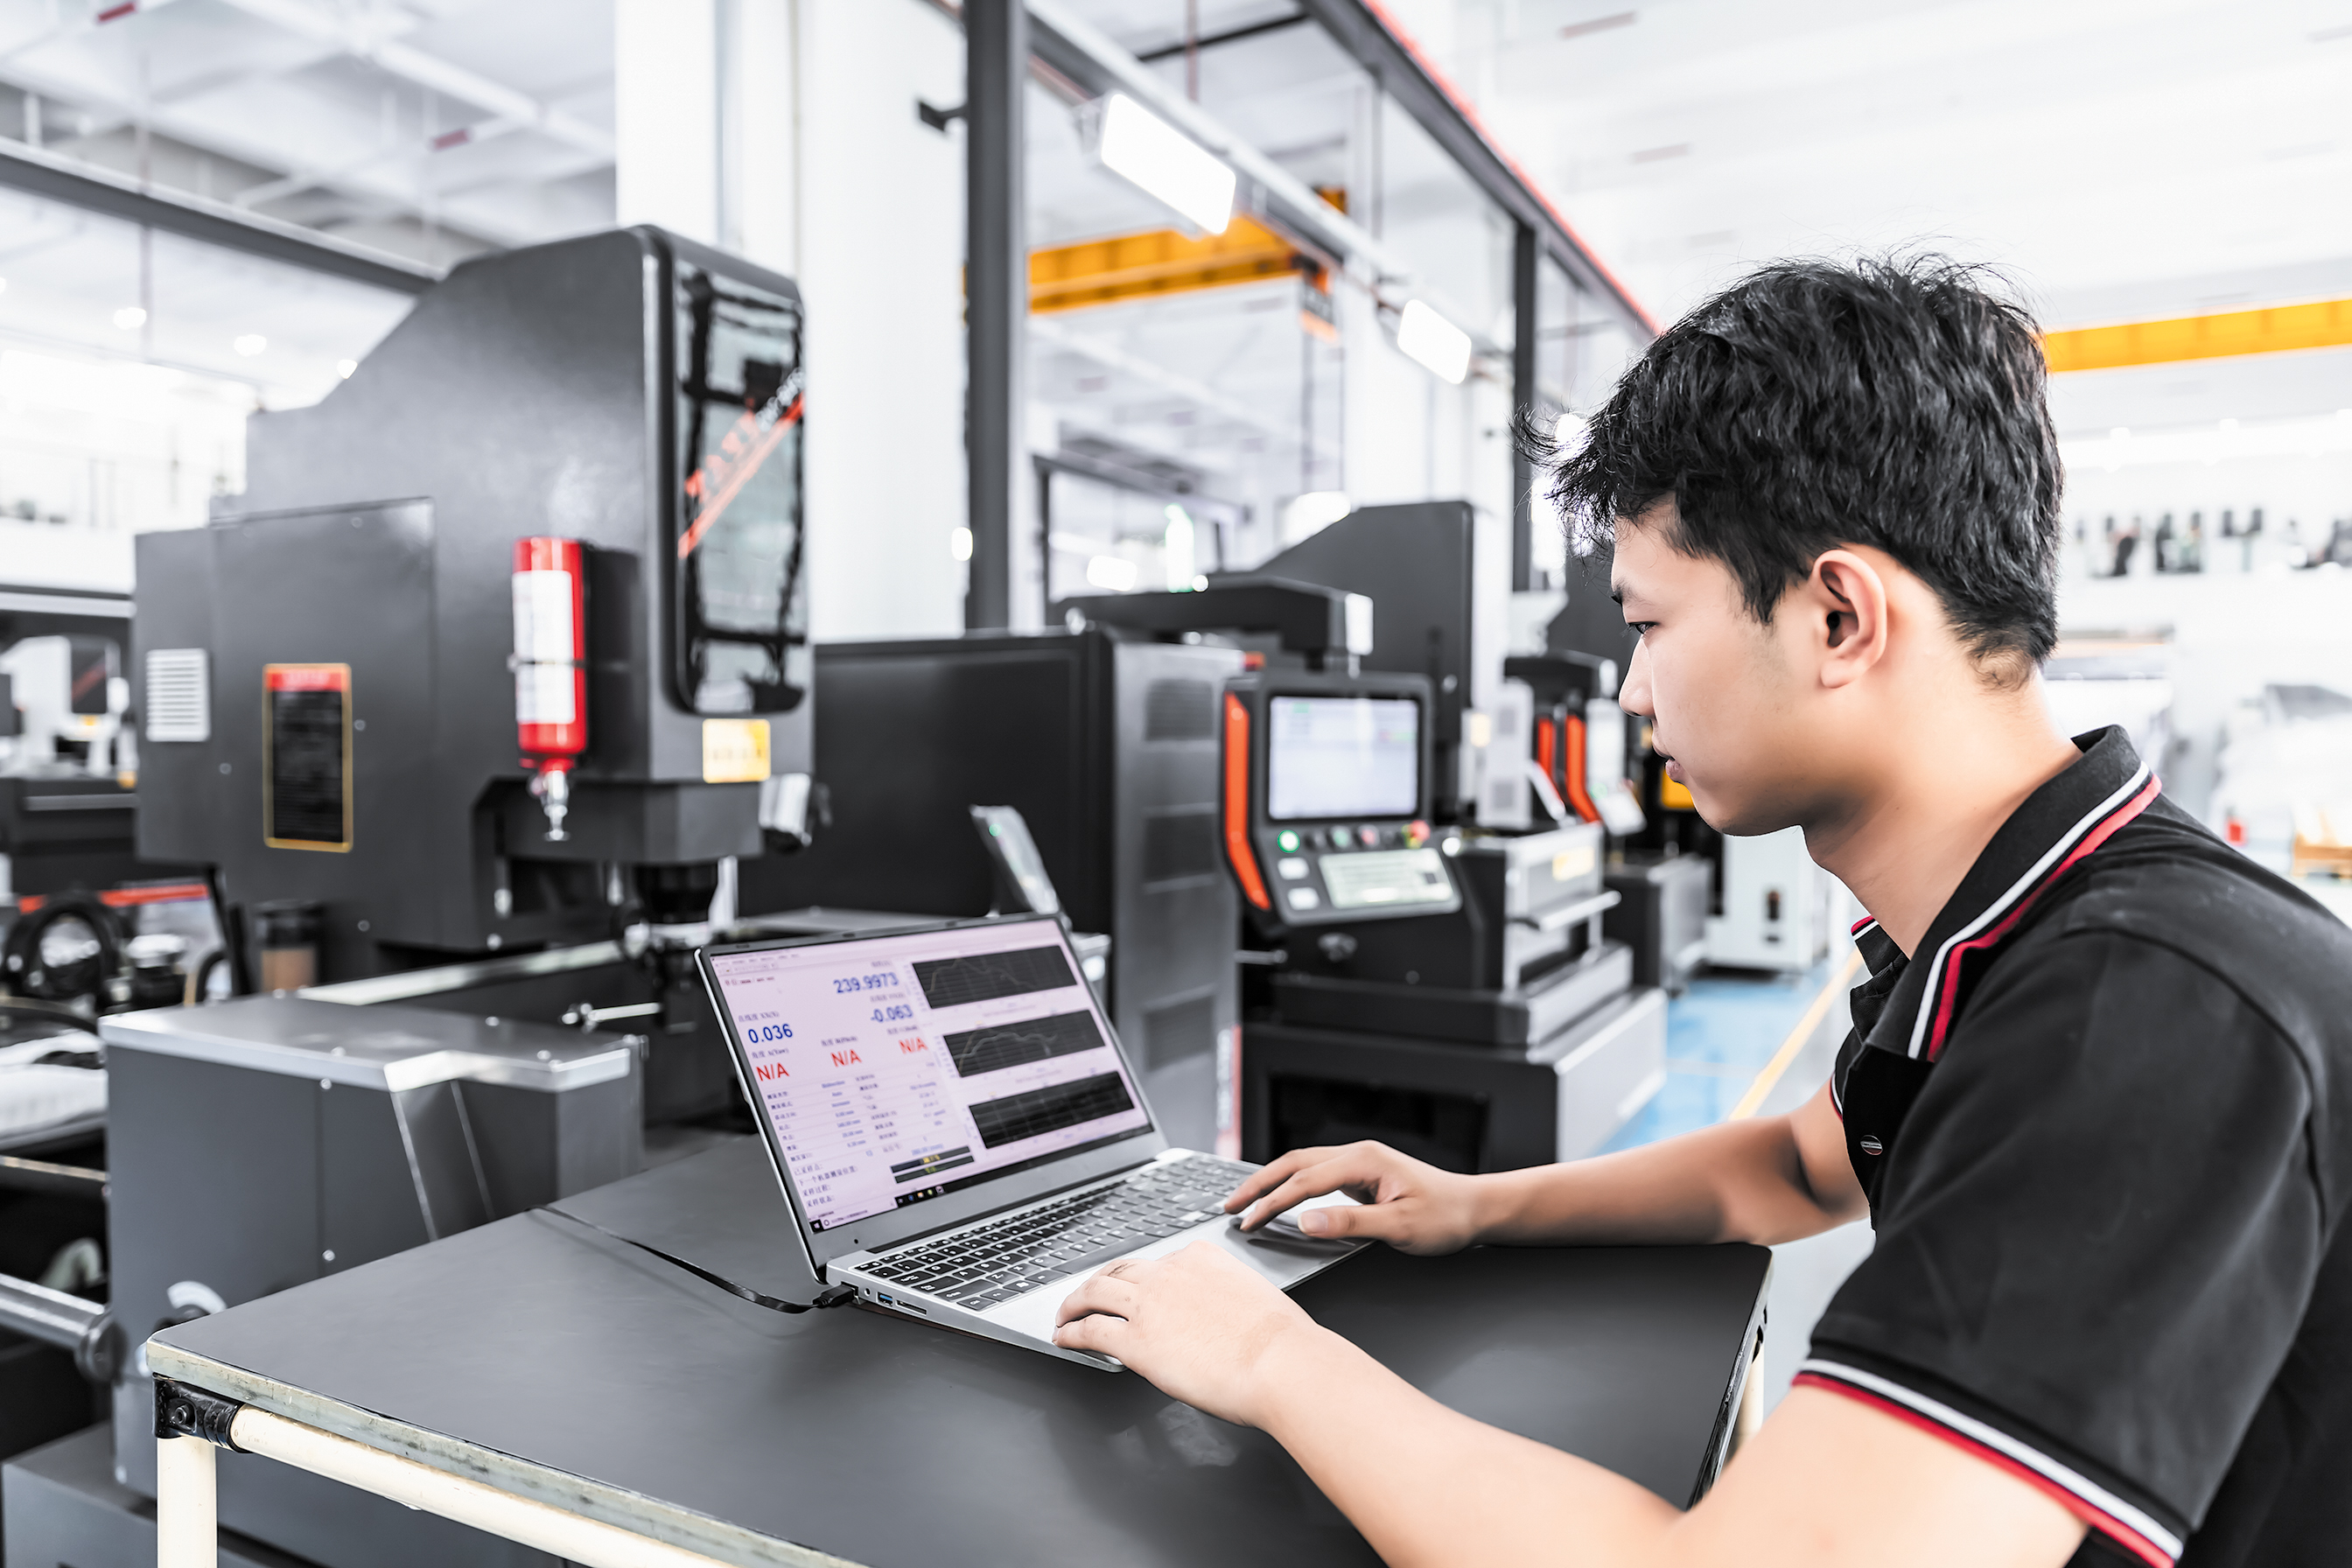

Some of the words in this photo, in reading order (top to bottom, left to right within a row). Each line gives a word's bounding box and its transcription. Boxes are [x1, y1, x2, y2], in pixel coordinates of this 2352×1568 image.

[833, 971, 900, 994] 239.9973
[870, 1004, 914, 1023] -0.063
[747, 1023, 794, 1044] 0.036
[898, 1036, 928, 1055] N/A
[830, 1048, 863, 1068] N/A
[756, 1061, 790, 1082] N/A
